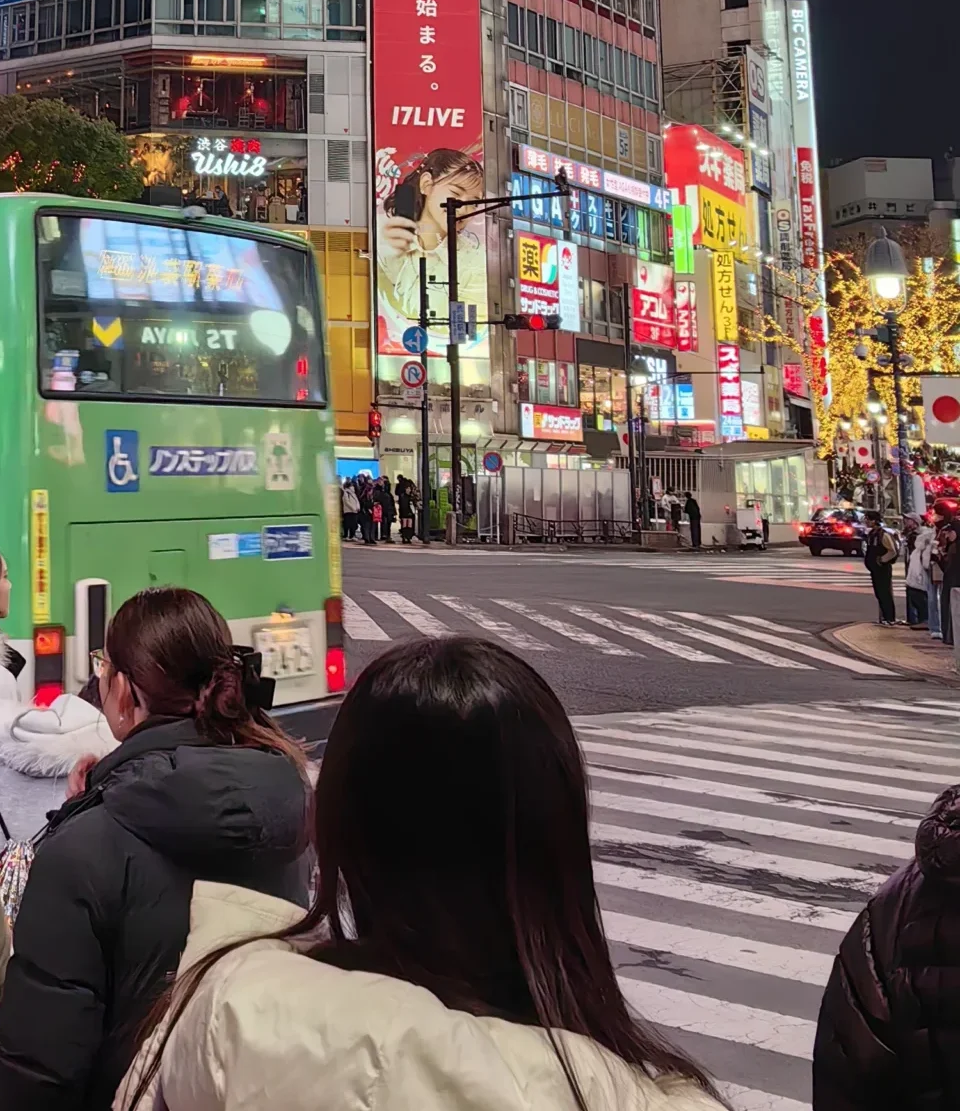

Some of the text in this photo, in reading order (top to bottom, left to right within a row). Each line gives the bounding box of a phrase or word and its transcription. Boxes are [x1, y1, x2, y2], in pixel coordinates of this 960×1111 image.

[791, 9, 809, 101] BIC CAMERA
[749, 60, 765, 102] OS
[190, 151, 268, 177] Ushi8
[619, 138, 629, 157] 5F
[698, 148, 746, 196] スギ薬局
[512, 179, 564, 229] AGA
[653, 188, 671, 210] 4F
[702, 196, 748, 249] 処方せん
[521, 241, 539, 279] 薬
[639, 293, 668, 320] アコム
[715, 253, 735, 341] 処方せん3F
[678, 309, 690, 338] アコム
[149, 449, 258, 474] ノンステップバス
